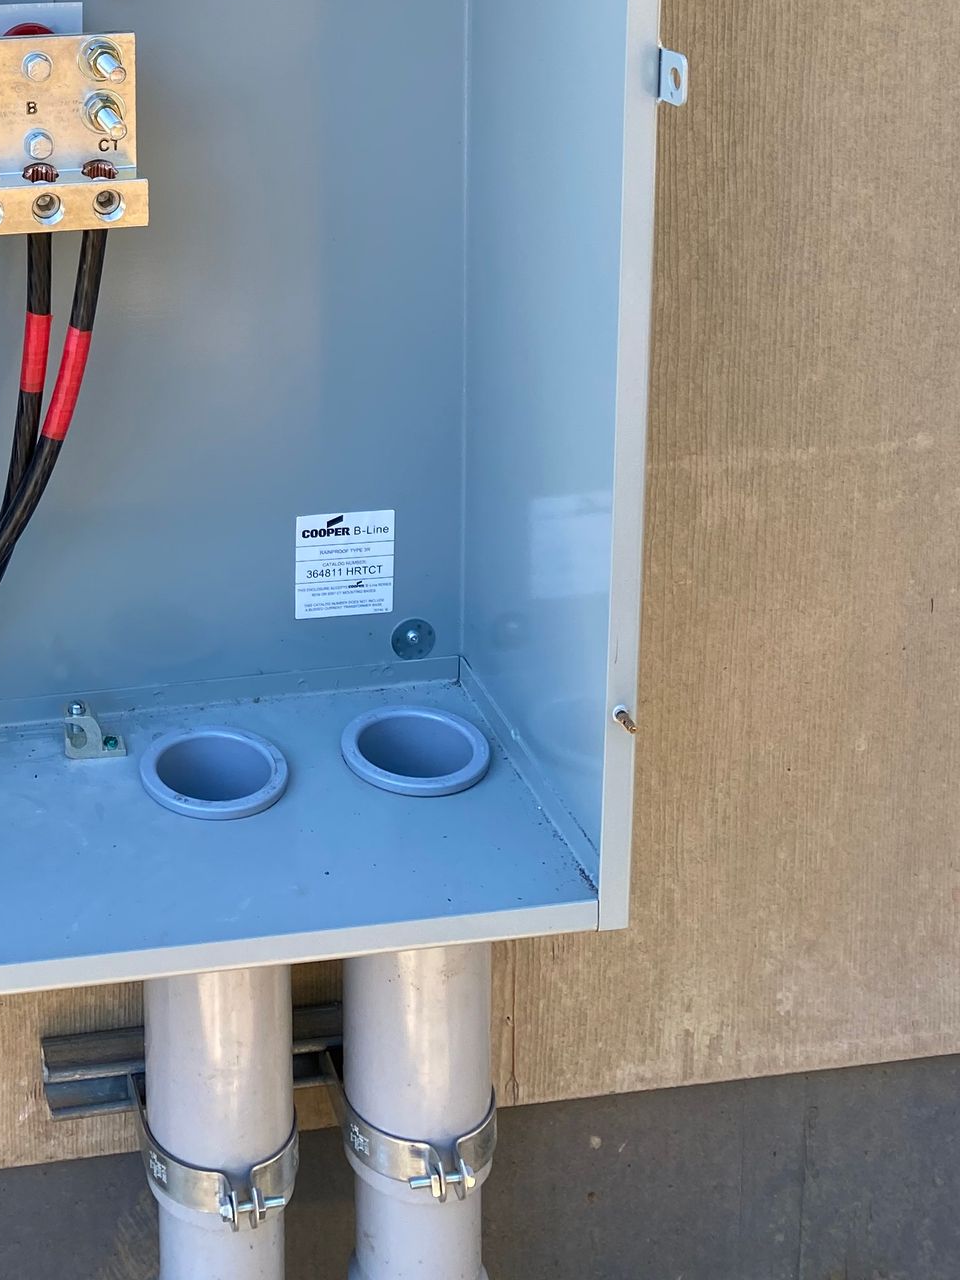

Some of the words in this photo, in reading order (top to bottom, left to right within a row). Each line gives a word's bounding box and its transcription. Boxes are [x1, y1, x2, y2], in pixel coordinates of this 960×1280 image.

[26, 101, 38, 115] B
[98, 139, 118, 152] CT
[302, 527, 350, 538] COOPER
[354, 525, 389, 535] B-Line
[306, 568, 342, 579] 364811
[346, 565, 383, 576] HRTCT
